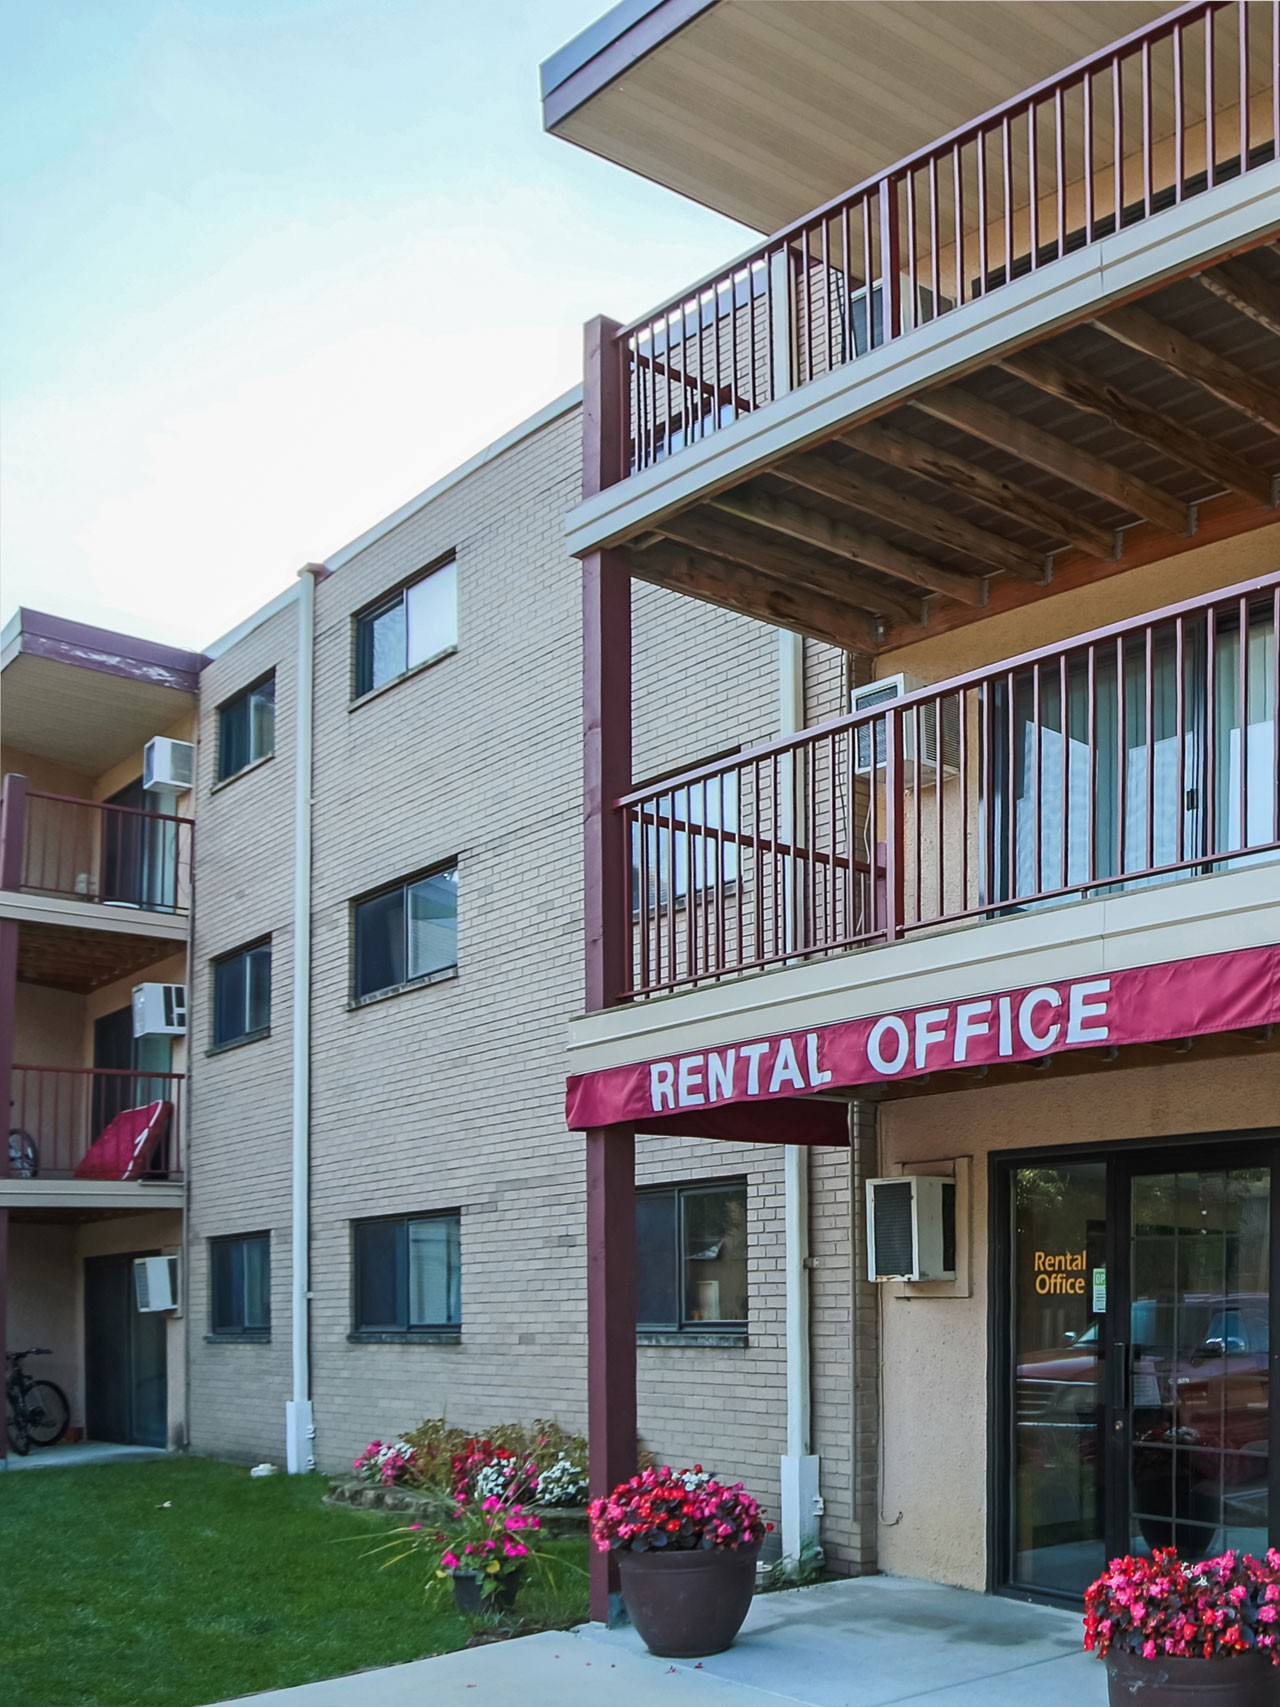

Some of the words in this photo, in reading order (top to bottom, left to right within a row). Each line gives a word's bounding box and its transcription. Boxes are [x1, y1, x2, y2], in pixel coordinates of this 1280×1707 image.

[648, 1031, 833, 1113] RENTAL
[866, 978, 1112, 1076] OFFICE
[1034, 1249, 1087, 1272] Rental
[1035, 1273, 1086, 1295] Office
